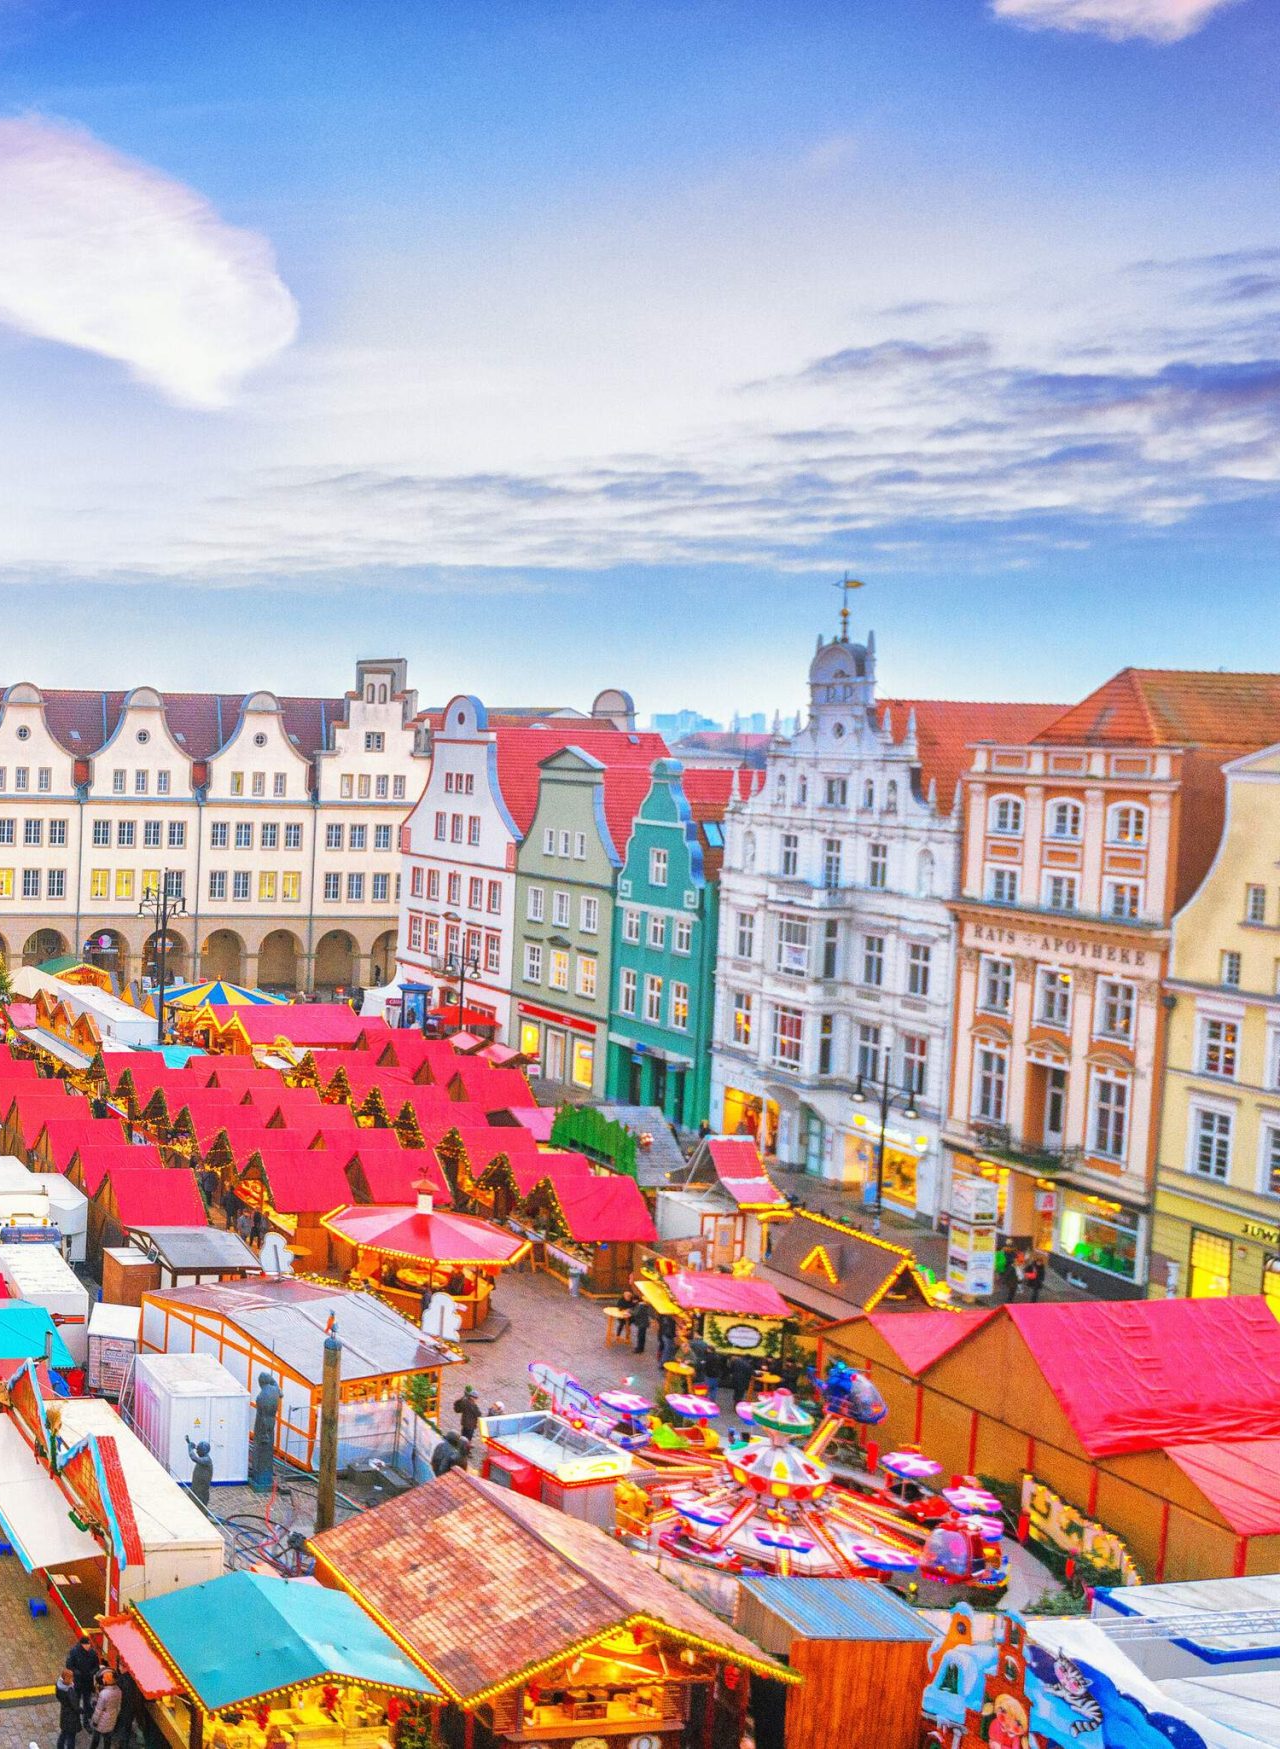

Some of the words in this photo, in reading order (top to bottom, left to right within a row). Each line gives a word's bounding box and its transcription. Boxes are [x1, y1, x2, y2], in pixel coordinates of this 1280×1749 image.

[973, 923, 1016, 945] RATS
[1040, 937, 1147, 967] APOTHEKE
[1241, 1223, 1280, 1243] JUW
